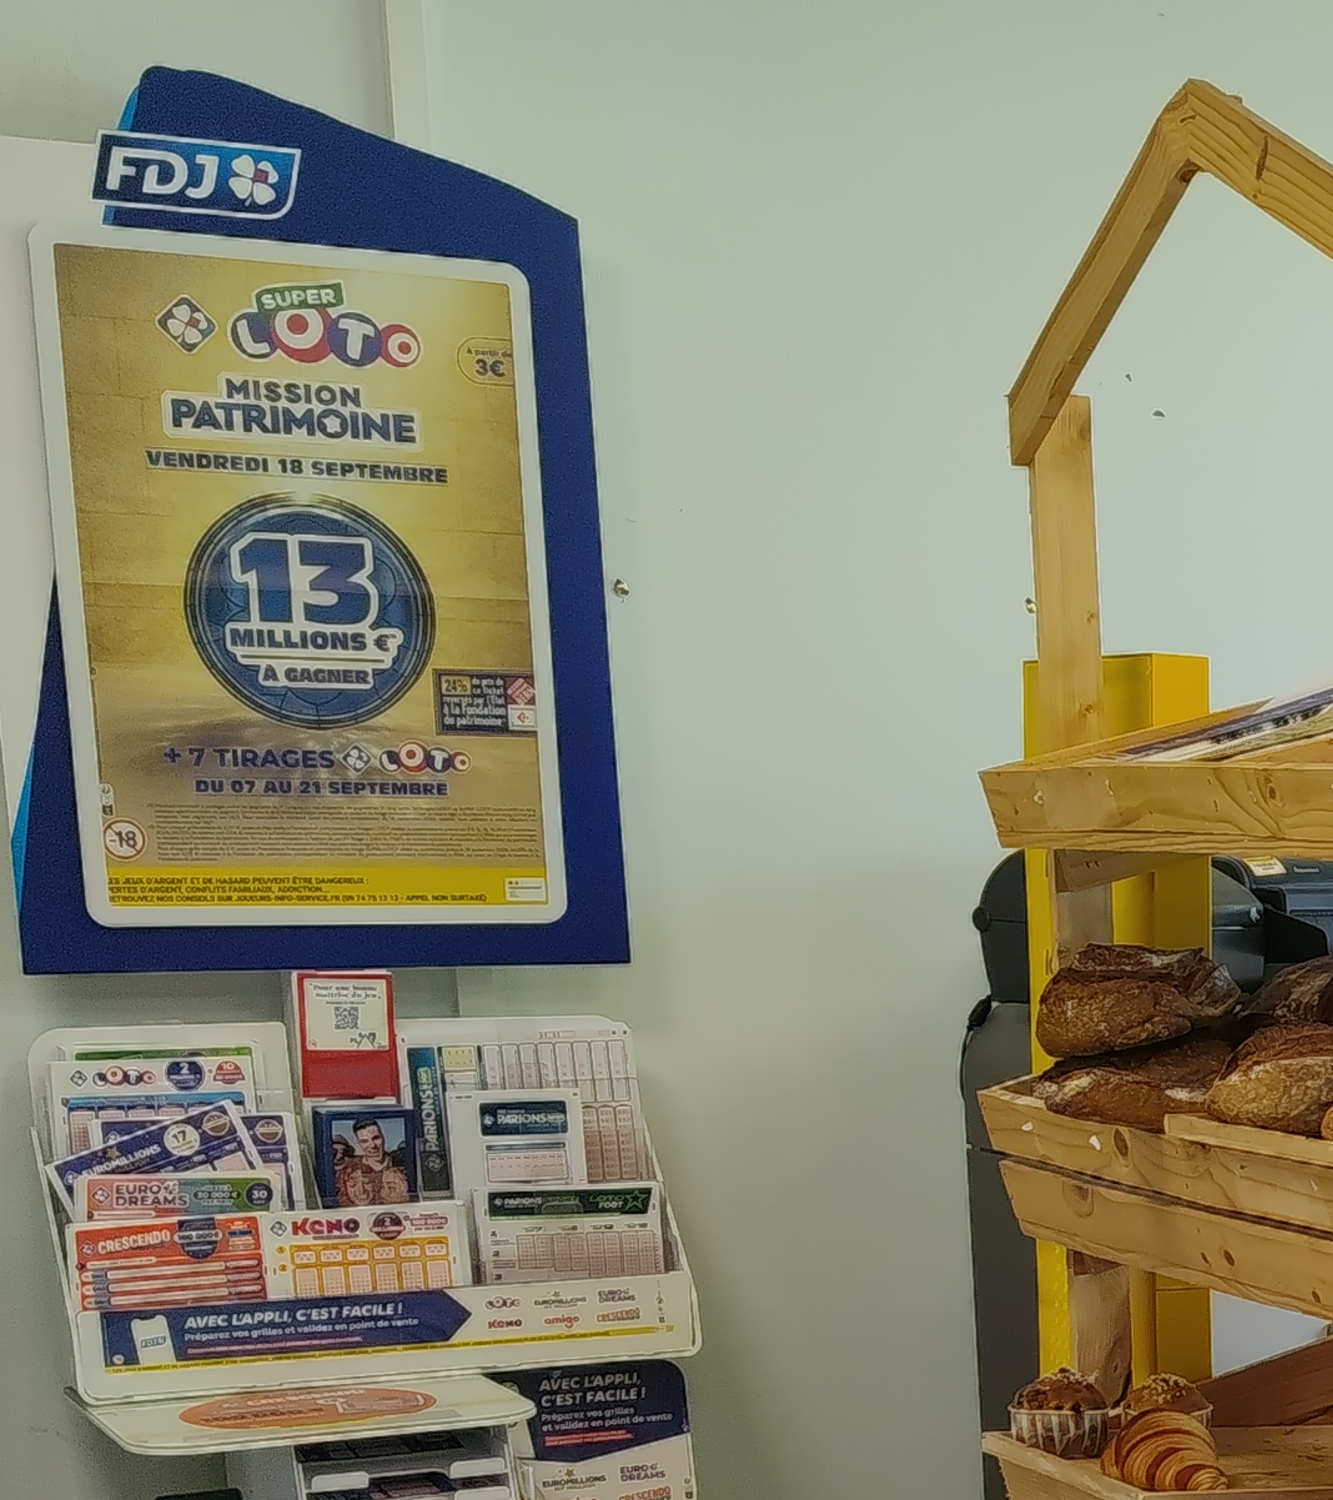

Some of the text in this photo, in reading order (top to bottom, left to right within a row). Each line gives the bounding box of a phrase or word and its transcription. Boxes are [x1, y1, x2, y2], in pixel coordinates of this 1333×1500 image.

[106, 146, 219, 199] FDJ
[259, 287, 337, 309] SUPER
[233, 307, 420, 366] LOTO
[475, 358, 505, 377] 3€
[225, 377, 362, 408] MISSION
[171, 398, 417, 443] PATRIMOINE
[145, 450, 449, 483] VENDREDI 18 SEPTEMBRE
[238, 537, 368, 623] 13
[230, 628, 367, 653] MILLIONS
[262, 663, 369, 685] À GAGNER
[444, 678, 468, 692] 24%
[188, 743, 472, 772] 7 TIRAGES LOTO
[195, 780, 448, 796] DU 07 AU 21 SEPTEMBRE
[109, 830, 138, 848] -18
[92, 1065, 156, 1087] LOTO
[419, 1089, 439, 1151] PARIONS
[171, 1129, 188, 1144] 17
[82, 1144, 162, 1178] EUROMILLIONS
[115, 1181, 161, 1195] EURO
[115, 1189, 268, 1209] DREAMS 30
[98, 1216, 361, 1254] CRESCENDO KENO
[185, 1303, 395, 1329] AVEC L'APPLI, C'EST FACILE
[543, 1313, 581, 1329] amigo
[184, 1317, 419, 1343] Préparez vos grilles et validez en point de vente
[539, 1371, 642, 1392] AVEC L'APPLI,
[541, 1388, 640, 1407] C'EST FACILE
[541, 1411, 585, 1423] Préparez
